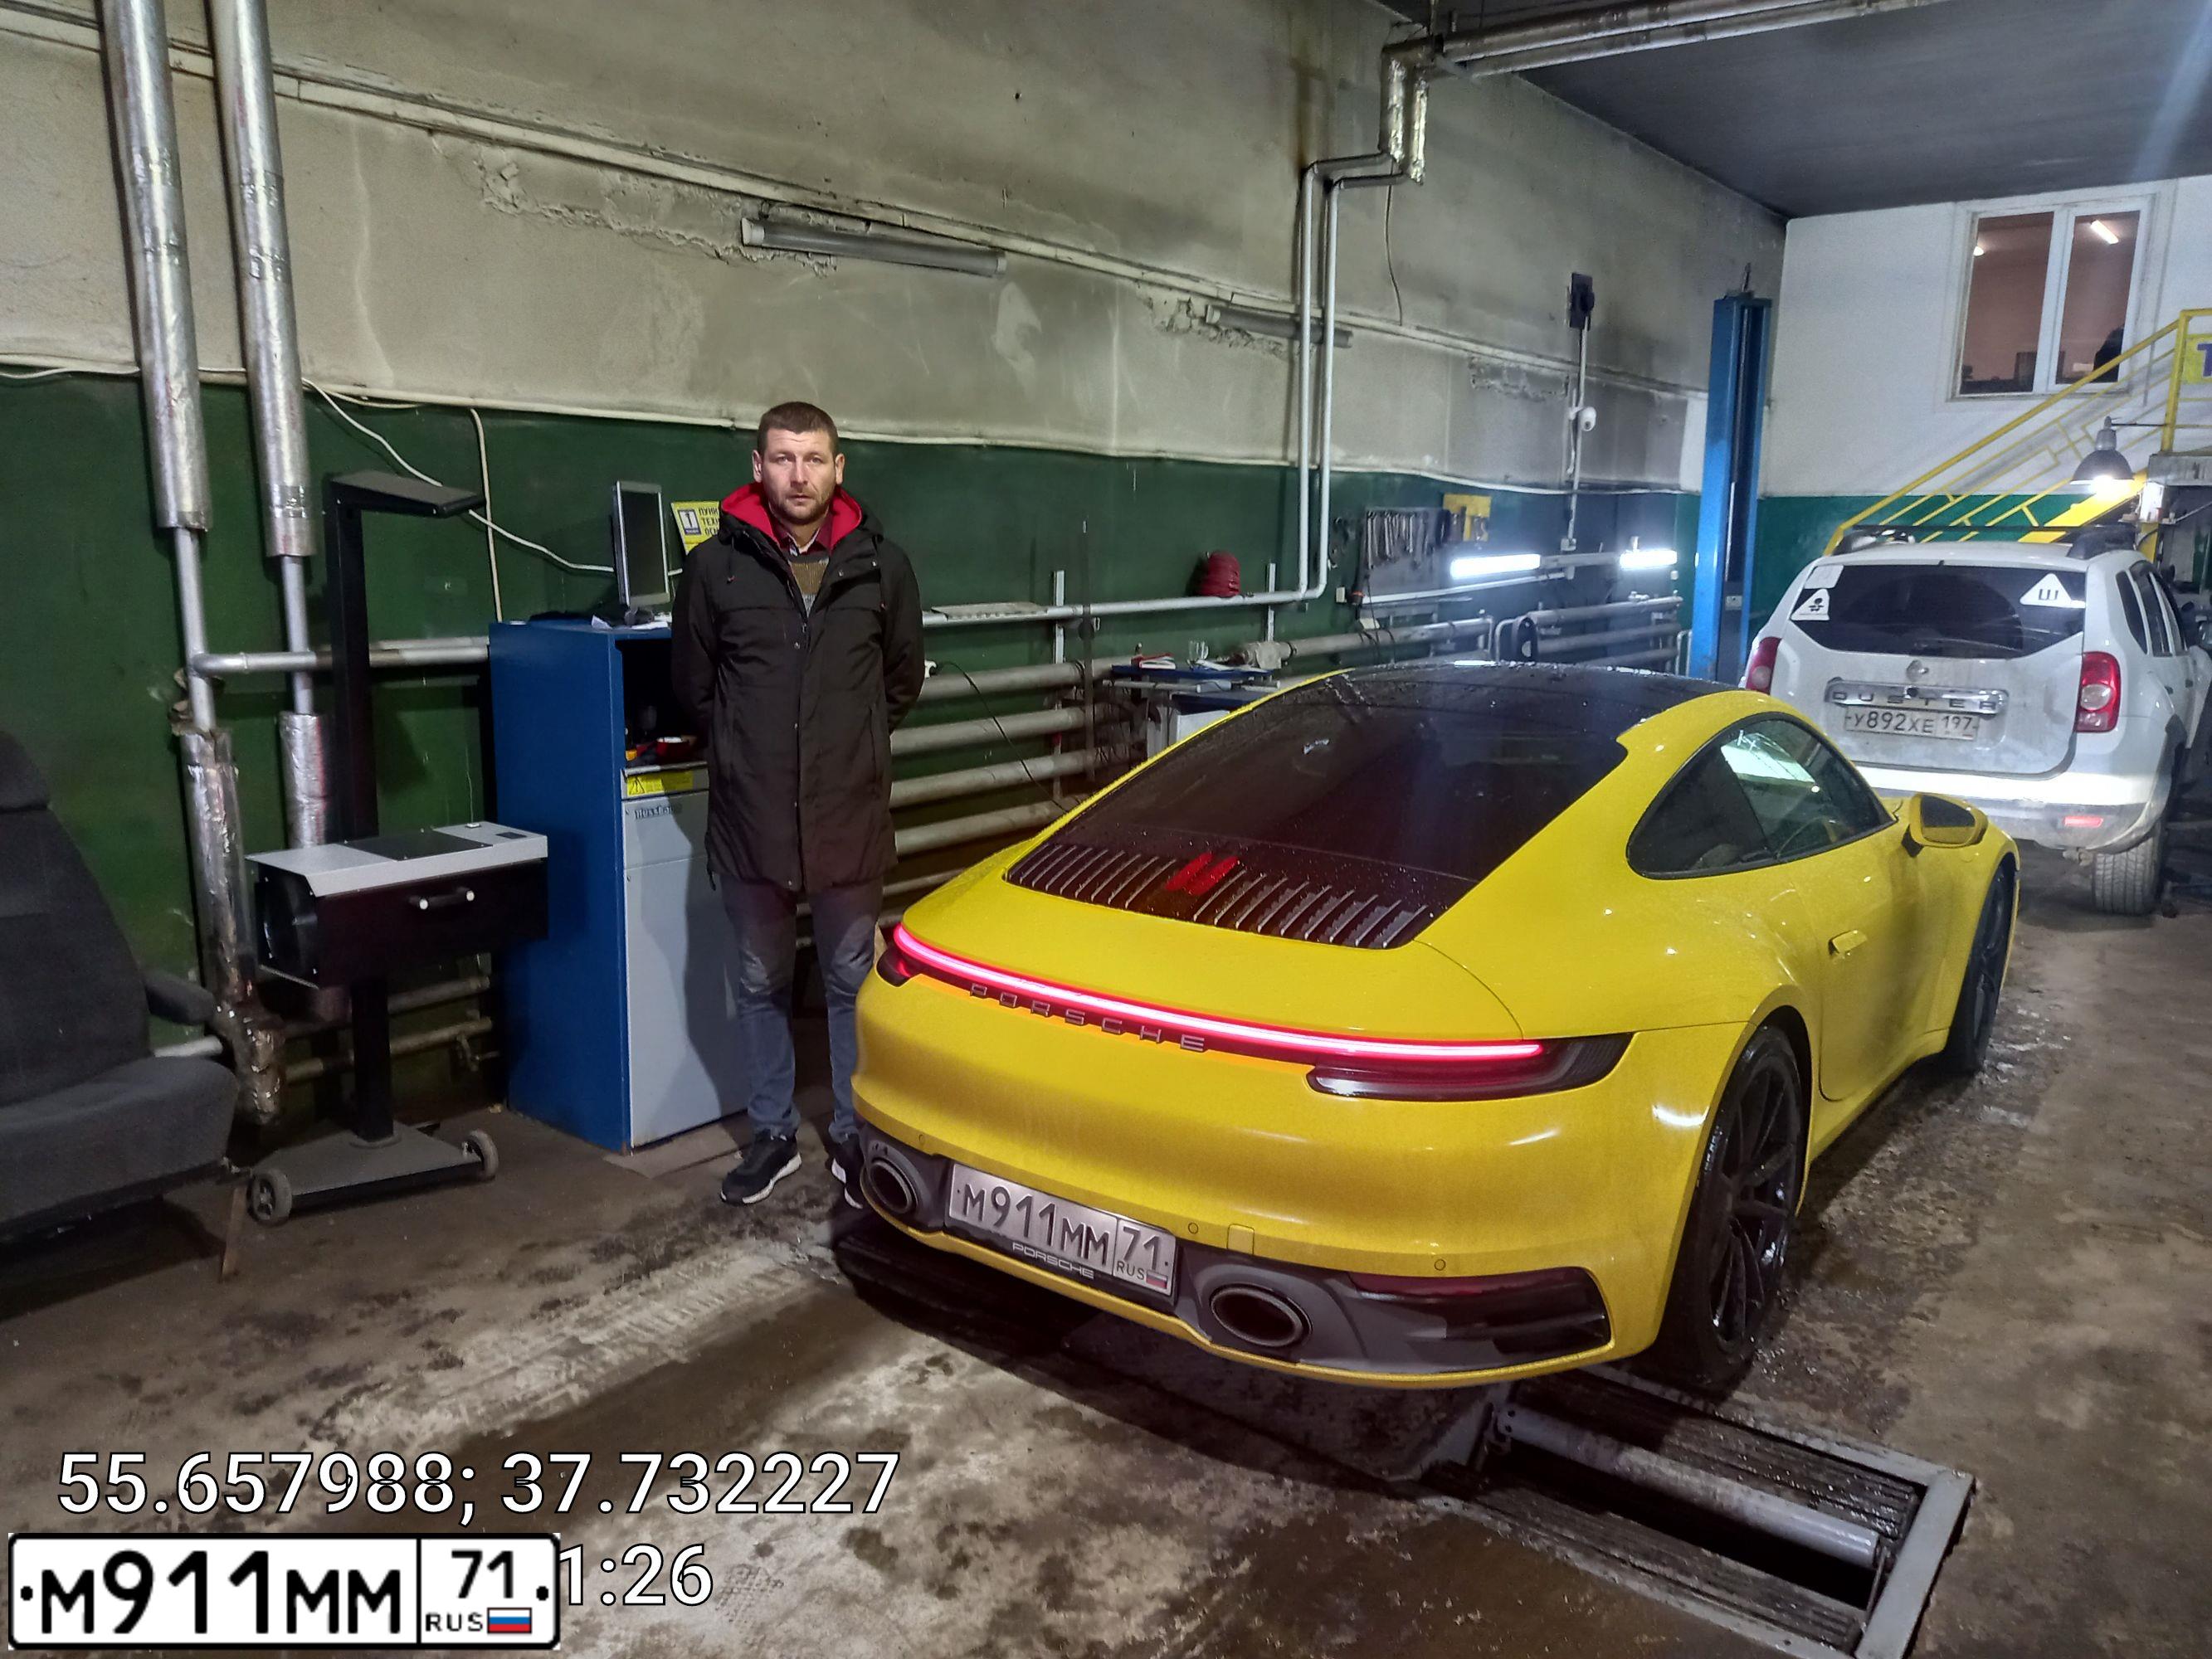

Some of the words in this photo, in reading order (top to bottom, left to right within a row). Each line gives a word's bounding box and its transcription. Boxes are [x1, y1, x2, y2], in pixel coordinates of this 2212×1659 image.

[1832, 691, 1996, 710] DUSTER
[1942, 714, 1972, 731] 197
[970, 982, 1205, 1052] PORSCHE
[962, 1184, 1110, 1267] М911ММ
[1123, 1225, 1161, 1271] 71
[1012, 1243, 1094, 1279] PORSCHE
[1116, 1261, 1145, 1281] RUS
